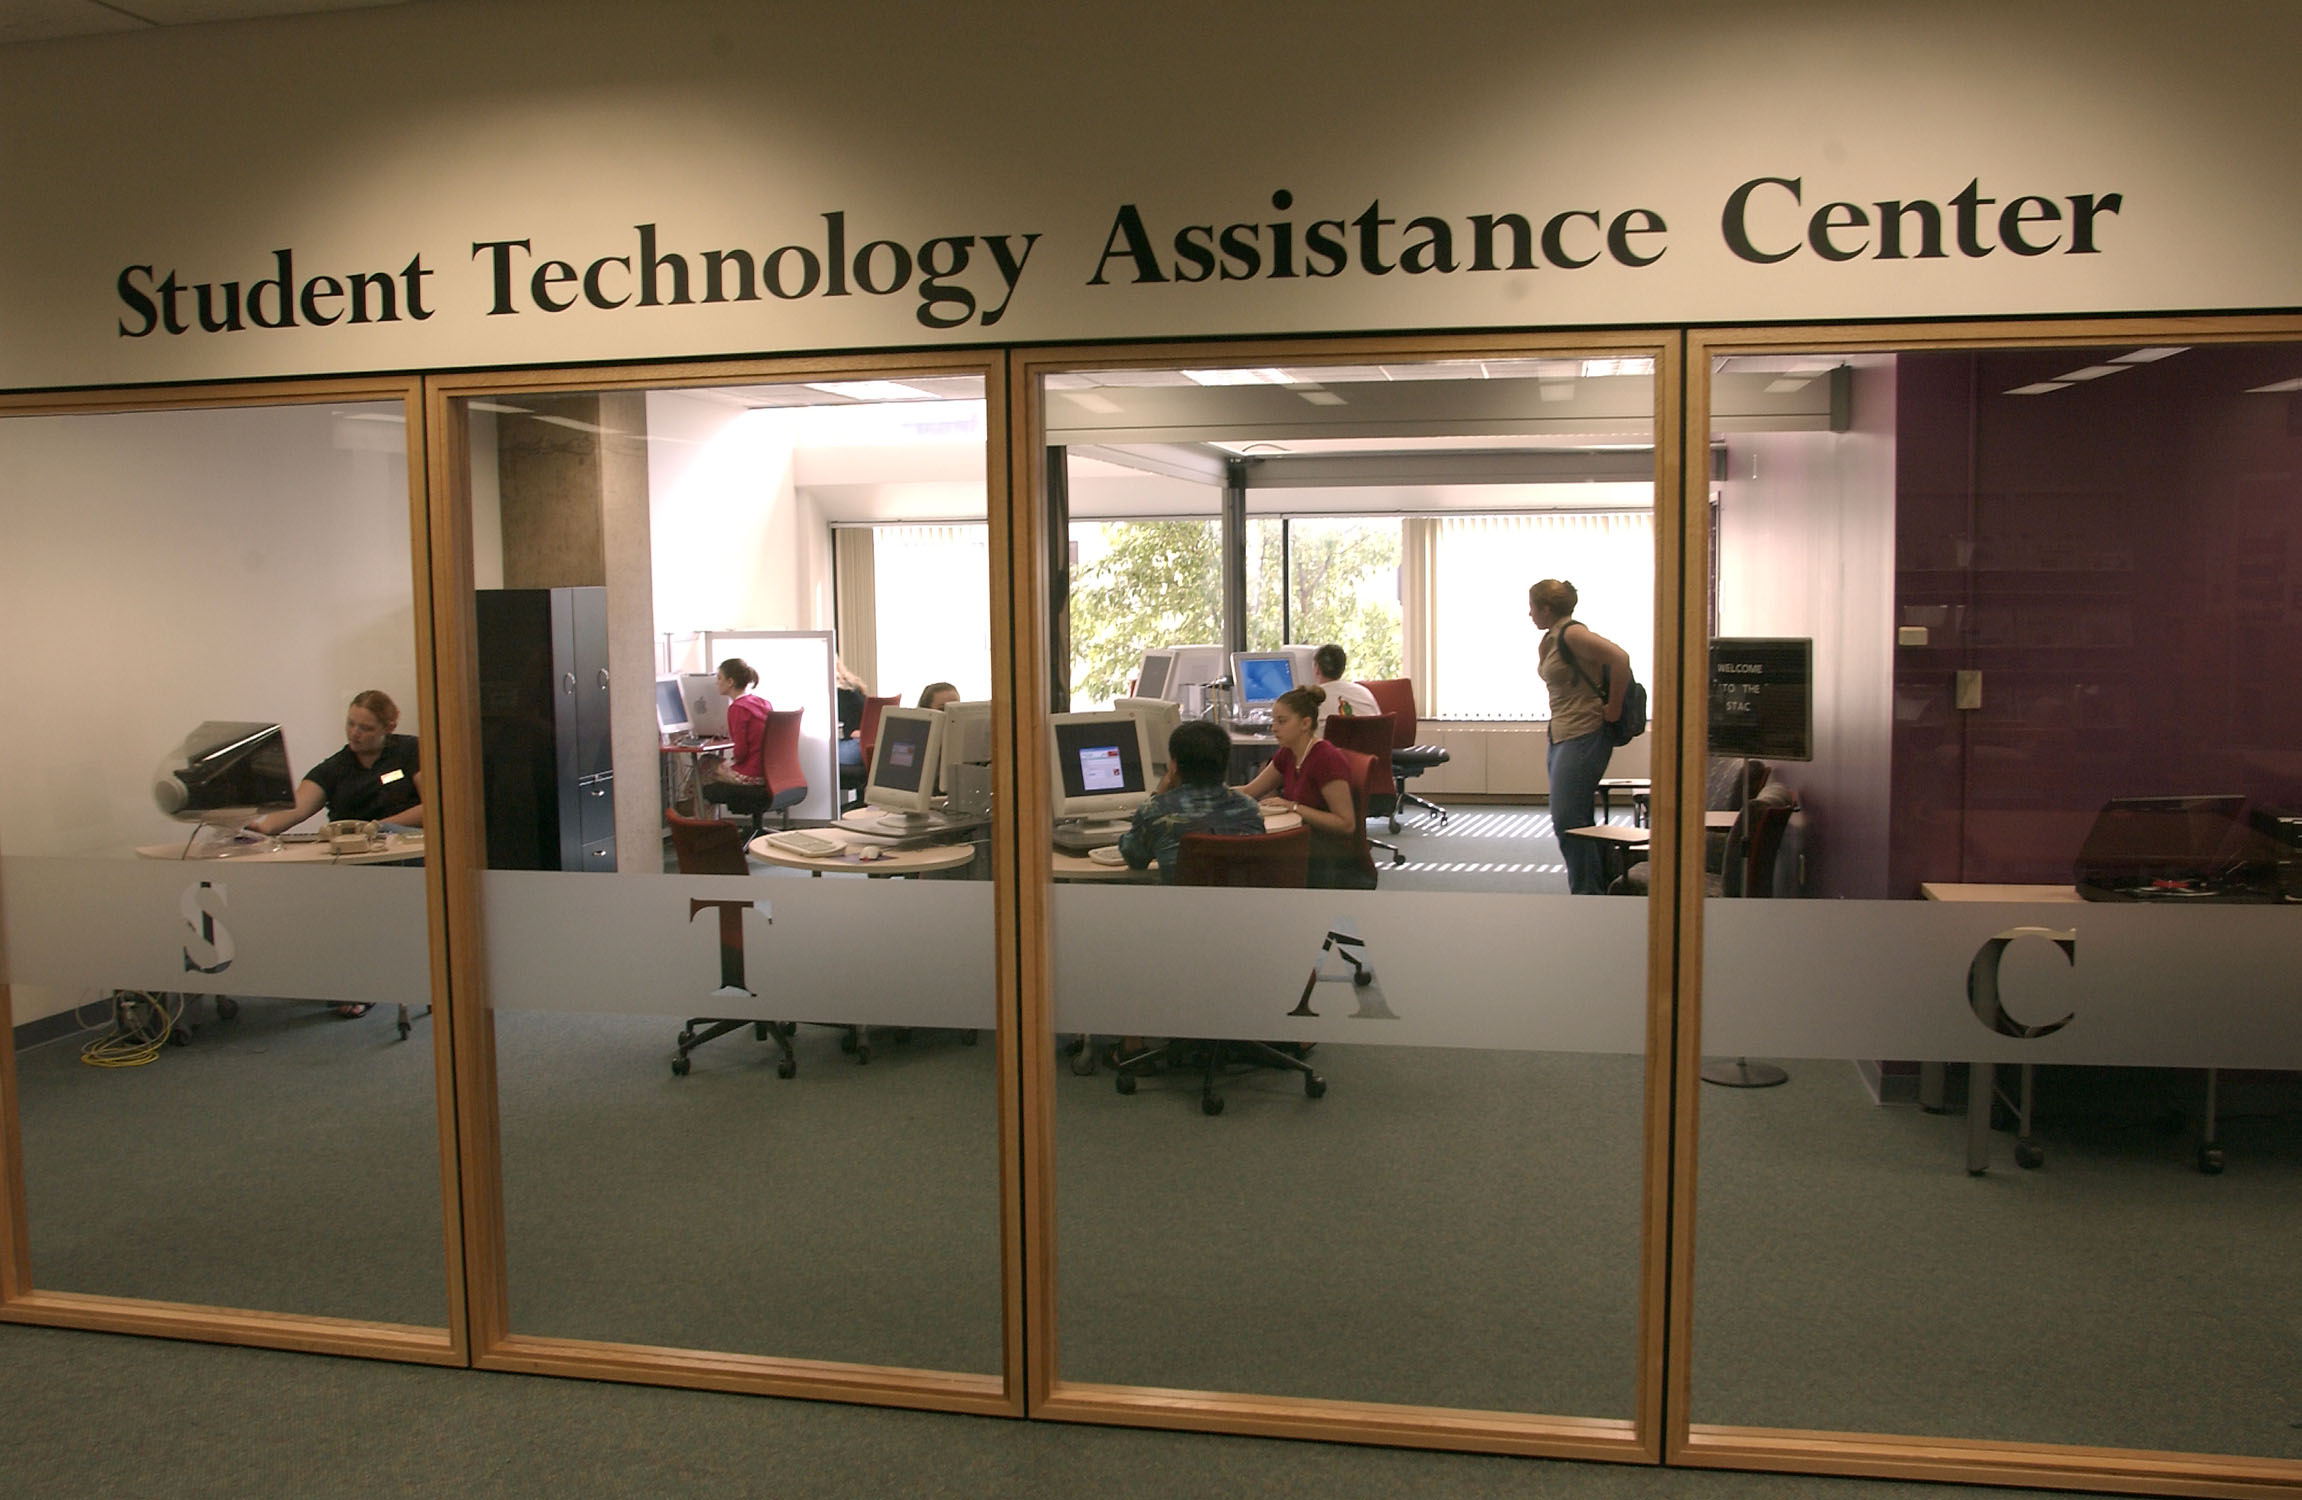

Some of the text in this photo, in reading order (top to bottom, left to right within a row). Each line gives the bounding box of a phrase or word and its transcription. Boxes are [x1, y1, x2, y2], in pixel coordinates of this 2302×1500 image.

[115, 177, 2123, 338] Student Technology Assistance Center
[1717, 663, 1764, 675] WELCOME
[1723, 682, 1761, 695] TO THE
[1725, 701, 1751, 712] STAC
[690, 897, 773, 998] T
[1286, 914, 1402, 1020] A
[1966, 926, 2077, 1039] C
